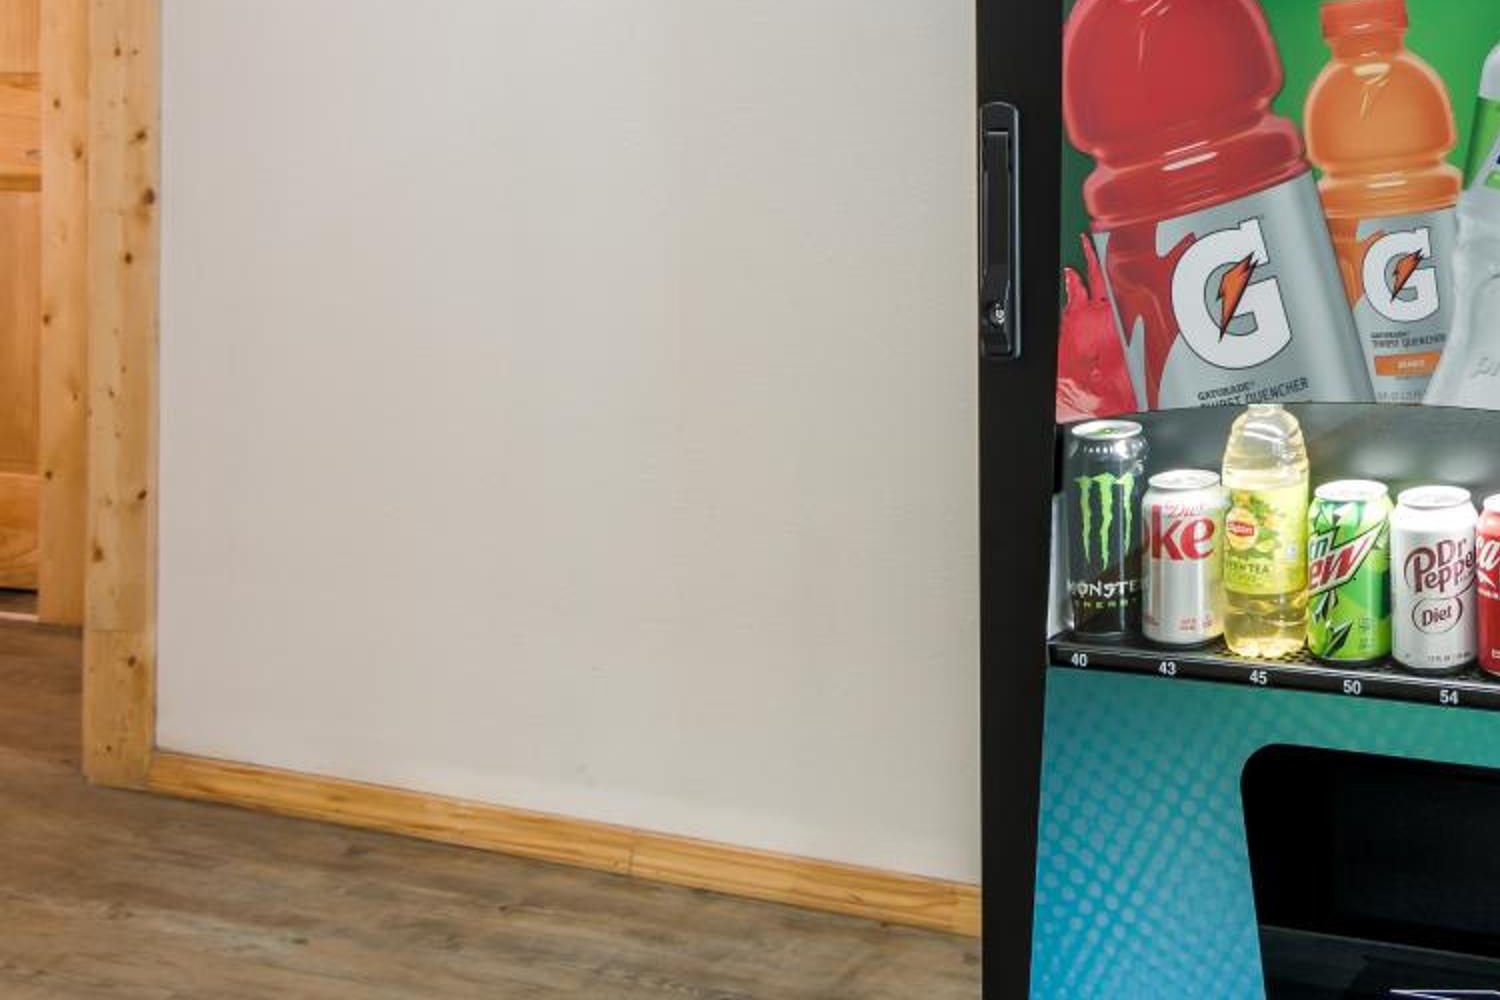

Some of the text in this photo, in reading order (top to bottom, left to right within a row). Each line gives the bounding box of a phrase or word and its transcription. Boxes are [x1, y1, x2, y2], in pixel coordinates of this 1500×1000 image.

[1362, 227, 1440, 322] G
[1171, 216, 1292, 369] G
[1437, 538, 1467, 567] Dr
[1420, 604, 1453, 627] Diet
[1072, 654, 1087, 667] 40
[1159, 662, 1177, 675] 43
[1250, 670, 1268, 684] 45
[1343, 681, 1361, 695] 50
[1440, 690, 1459, 704] 54
